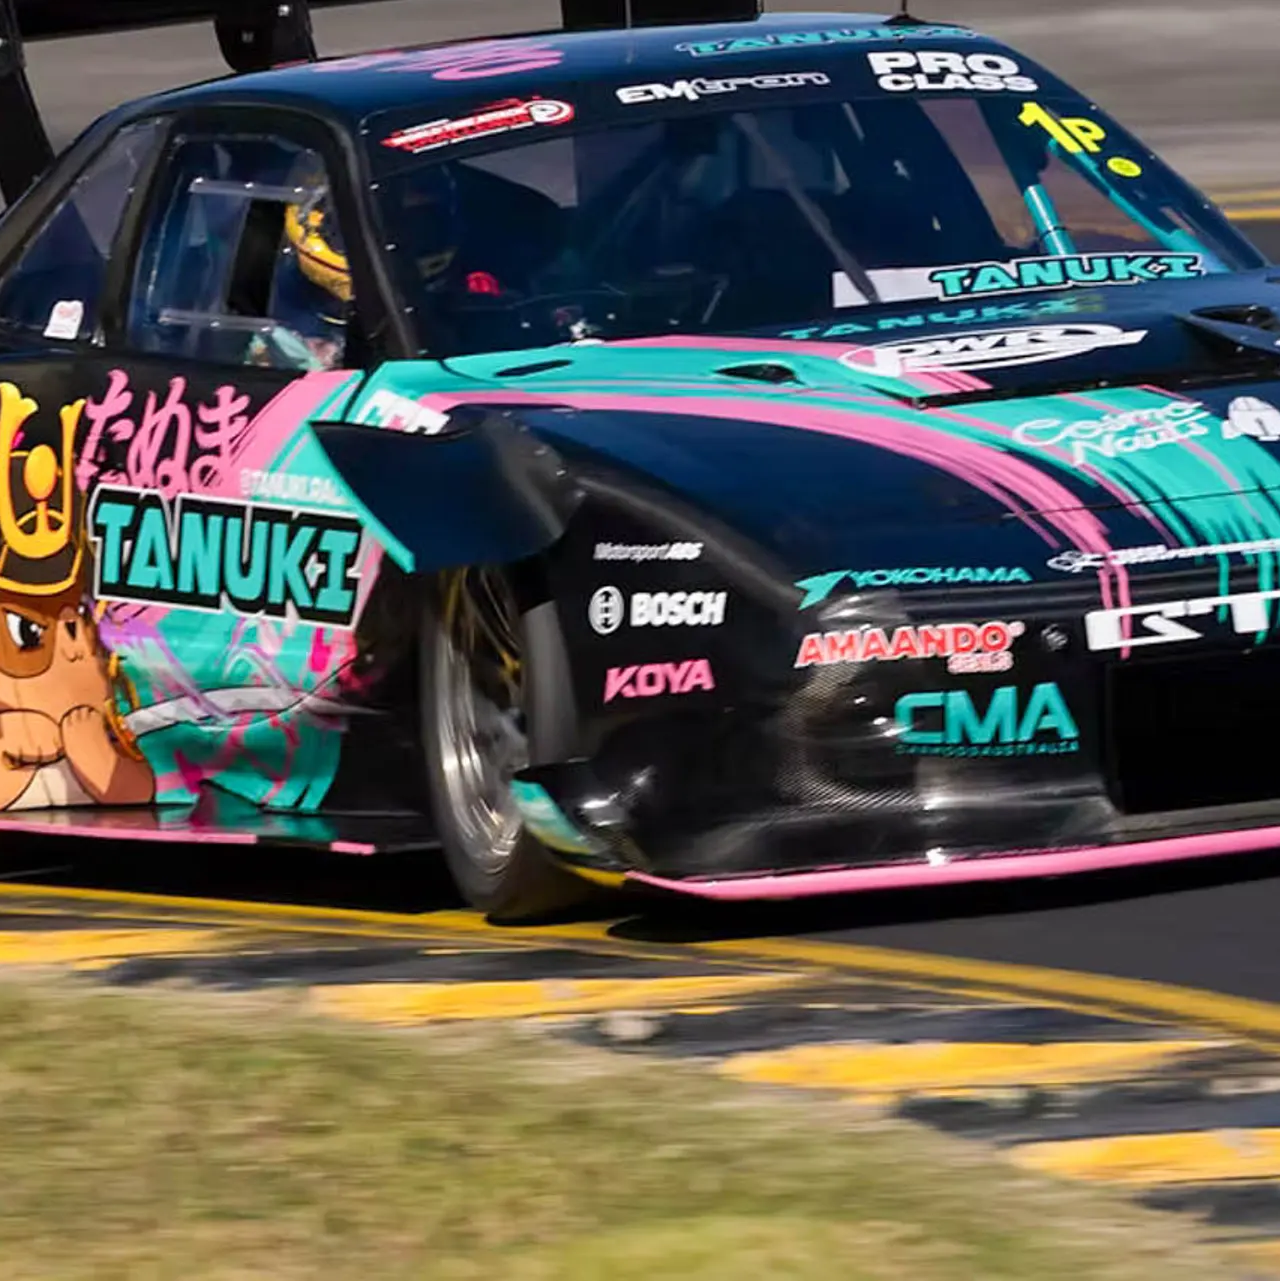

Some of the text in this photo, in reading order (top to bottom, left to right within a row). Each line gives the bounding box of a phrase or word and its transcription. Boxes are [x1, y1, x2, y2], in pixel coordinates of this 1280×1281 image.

[867, 51, 1019, 76] PRO
[878, 73, 1039, 93] CLASS
[930, 256, 1200, 296] TANUKI
[95, 503, 359, 612] TANUKI
[848, 567, 1033, 588] YOKOHAMA
[630, 592, 727, 627] BOSCH
[794, 622, 1014, 668] AMAANDO
[604, 659, 715, 703] KOYA
[894, 681, 1080, 745] CMA
